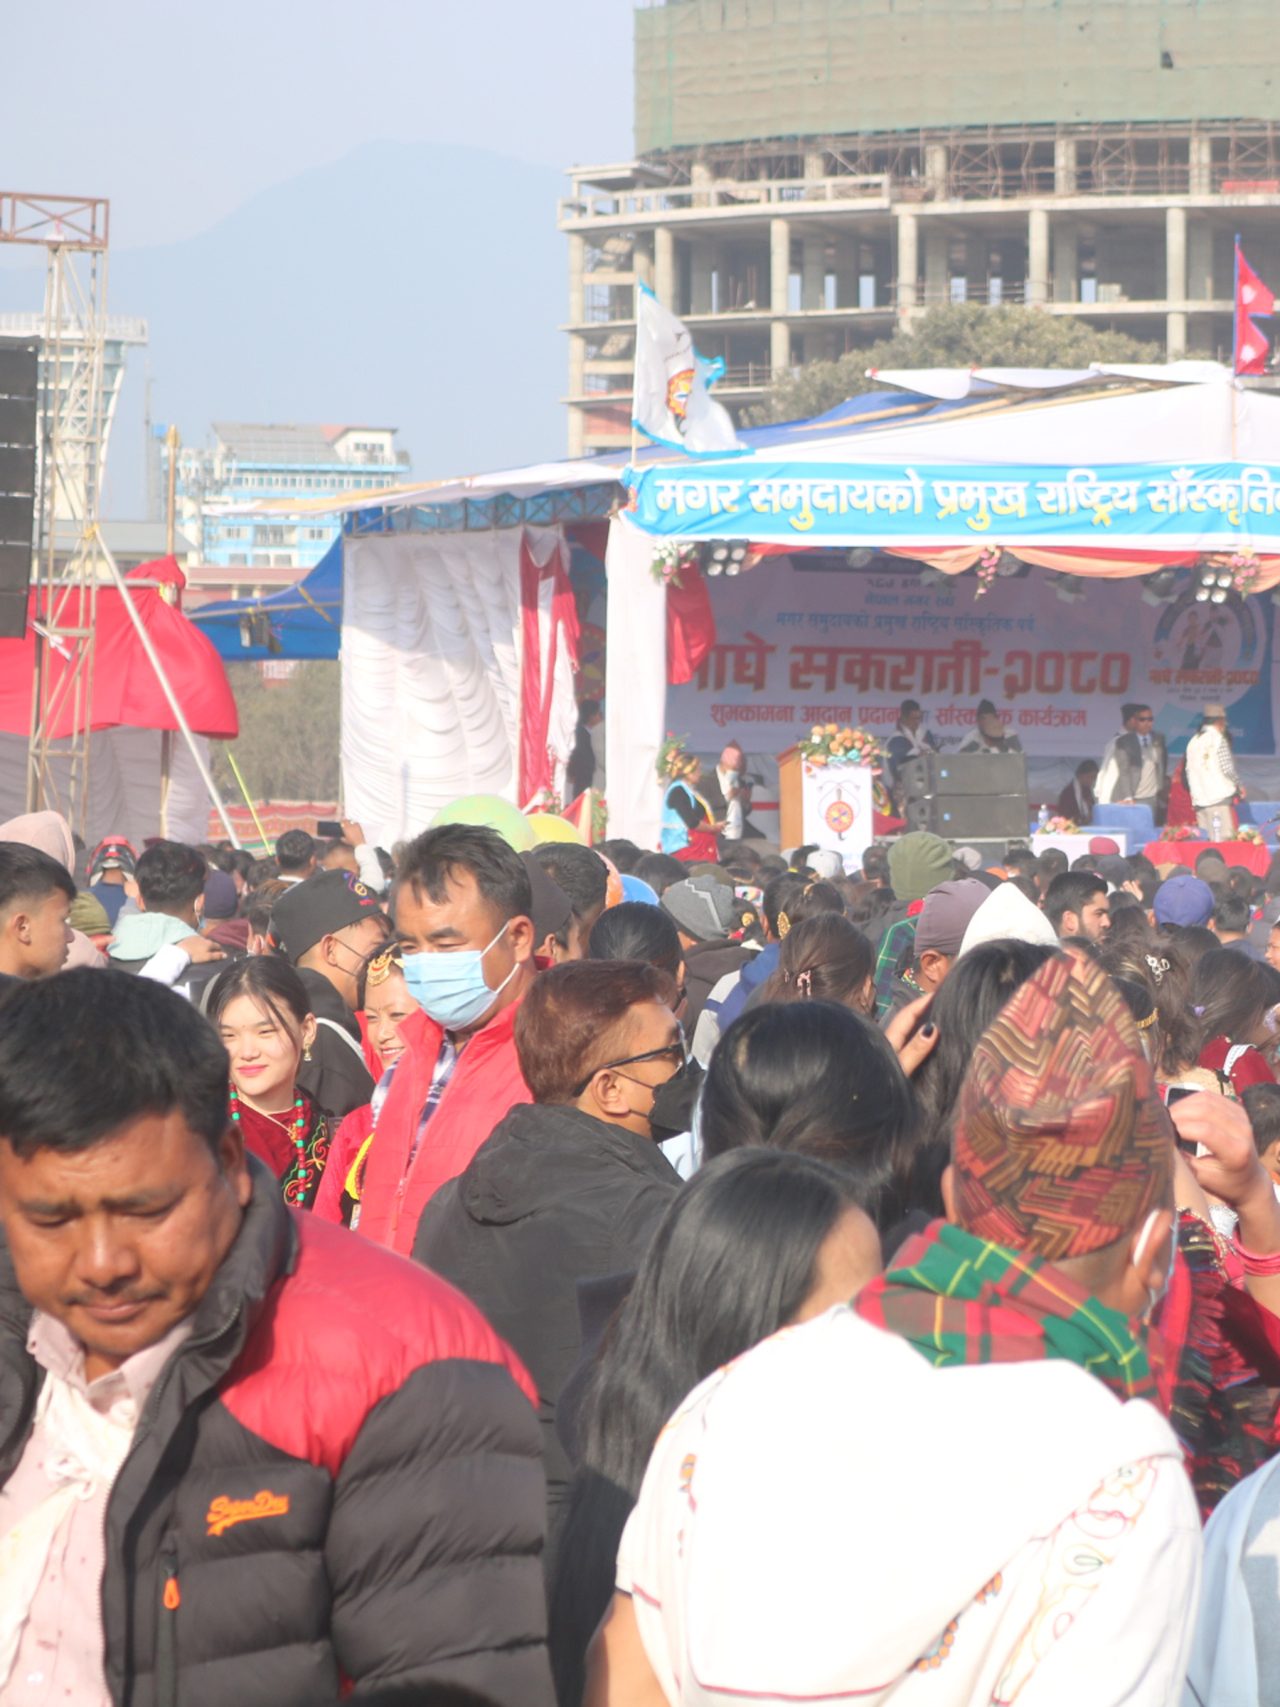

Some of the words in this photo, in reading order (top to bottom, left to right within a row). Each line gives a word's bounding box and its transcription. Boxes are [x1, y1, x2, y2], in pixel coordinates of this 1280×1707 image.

[654, 478, 745, 515] मगर
[747, 467, 926, 531] समुदायको
[930, 478, 1030, 531] प्रमुख
[1035, 468, 1143, 528] राष्ट्रिय
[697, 631, 777, 692] ाघे
[711, 704, 795, 728] शुभकामना
[801, 705, 852, 724] आदान
[1018, 703, 1087, 728] कार्यक्रम
